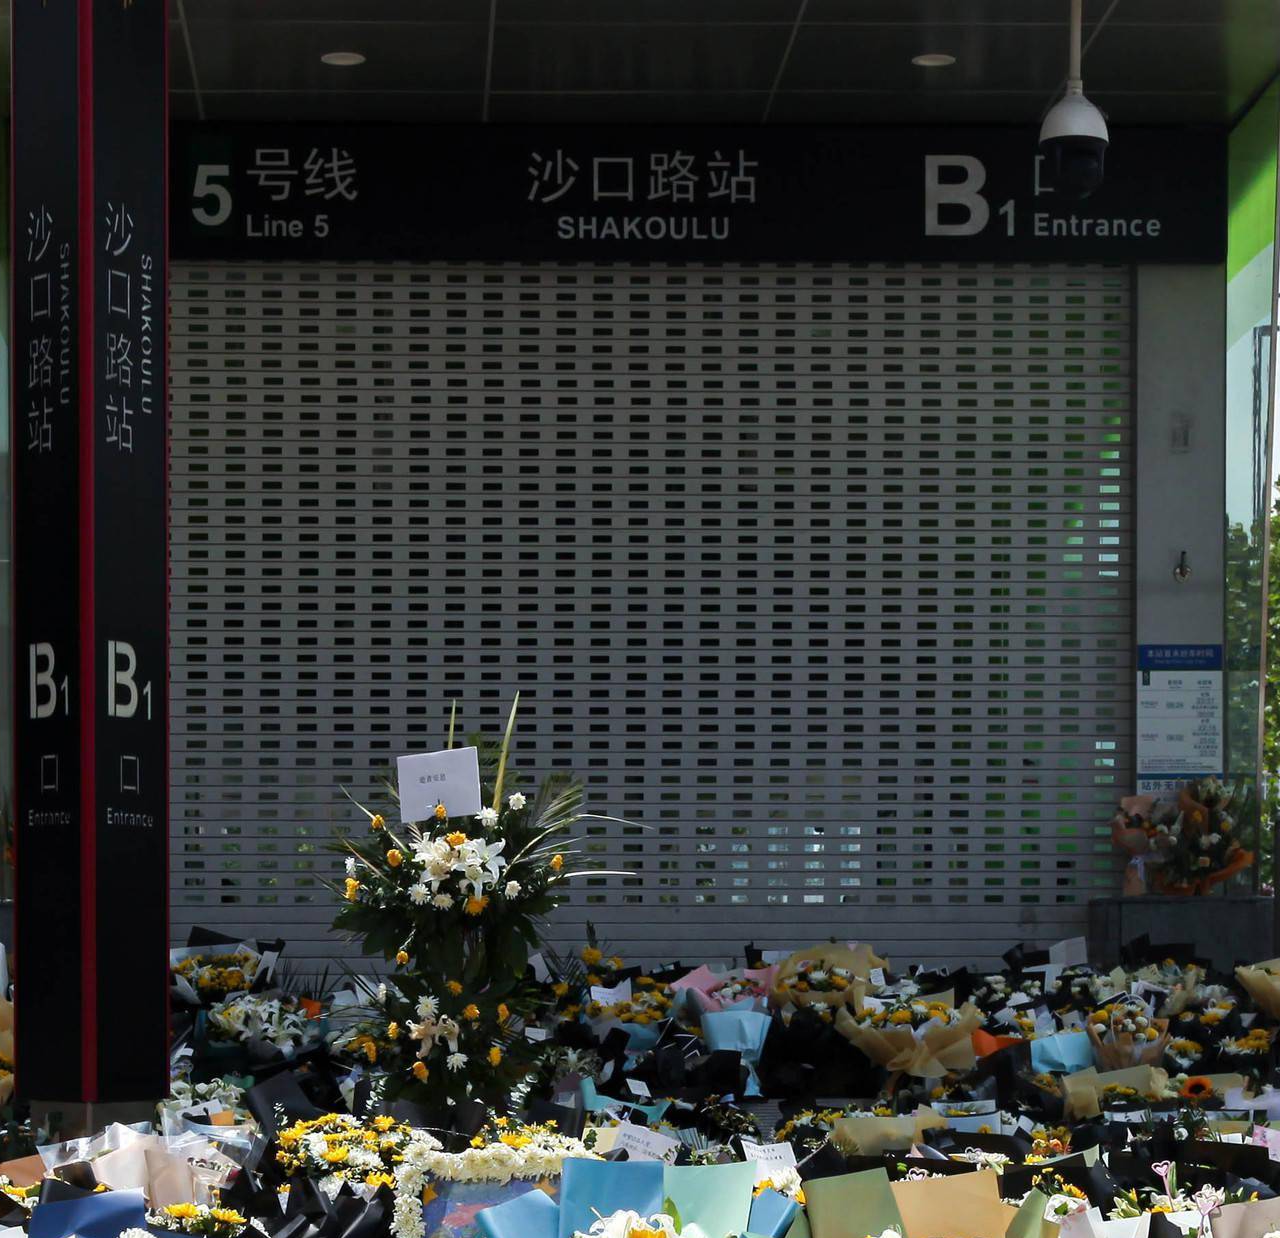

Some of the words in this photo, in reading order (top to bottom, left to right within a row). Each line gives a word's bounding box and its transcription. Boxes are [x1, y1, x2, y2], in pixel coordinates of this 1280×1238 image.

[246, 148, 359, 202] 号线
[526, 148, 760, 204] 沙口路站
[246, 214, 303, 238] Line
[313, 214, 330, 238] 5
[557, 215, 730, 241] SHAKOULU
[1034, 213, 1161, 237] Entrance
[27, 202, 54, 454] 沙口路站
[59, 242, 71, 405] SHAKOULU
[104, 200, 134, 454] 沙口路站
[140, 253, 153, 415] SHAKOULU
[29, 641, 69, 720] B1
[107, 639, 152, 721] B1
[107, 807, 153, 828] Entrance
